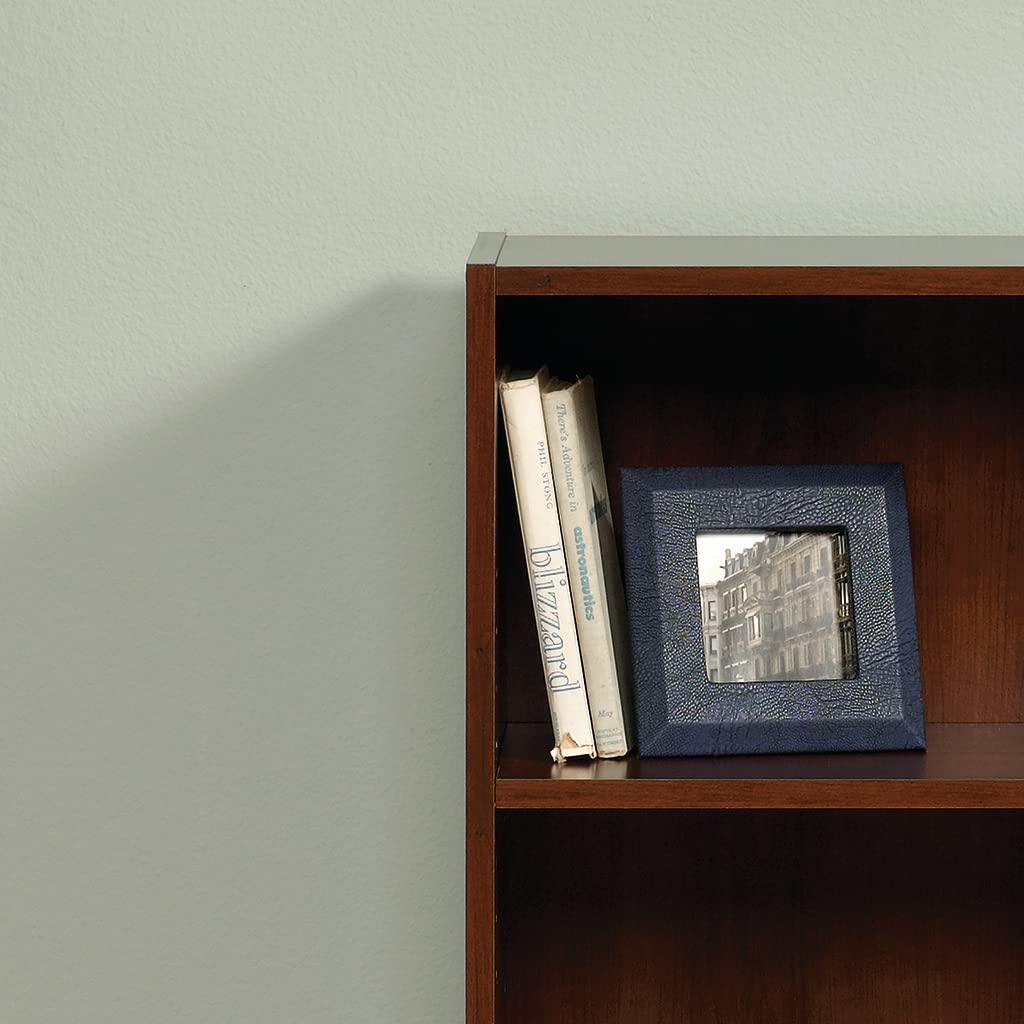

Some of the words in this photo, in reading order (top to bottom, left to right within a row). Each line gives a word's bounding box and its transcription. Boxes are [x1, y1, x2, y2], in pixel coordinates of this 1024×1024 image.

[556, 403, 569, 442] There's
[537, 441, 548, 468] PHIL
[561, 444, 575, 498] Adventure
[569, 501, 579, 513] in
[573, 526, 597, 622] astronautics
[529, 543, 581, 692] blizzard
